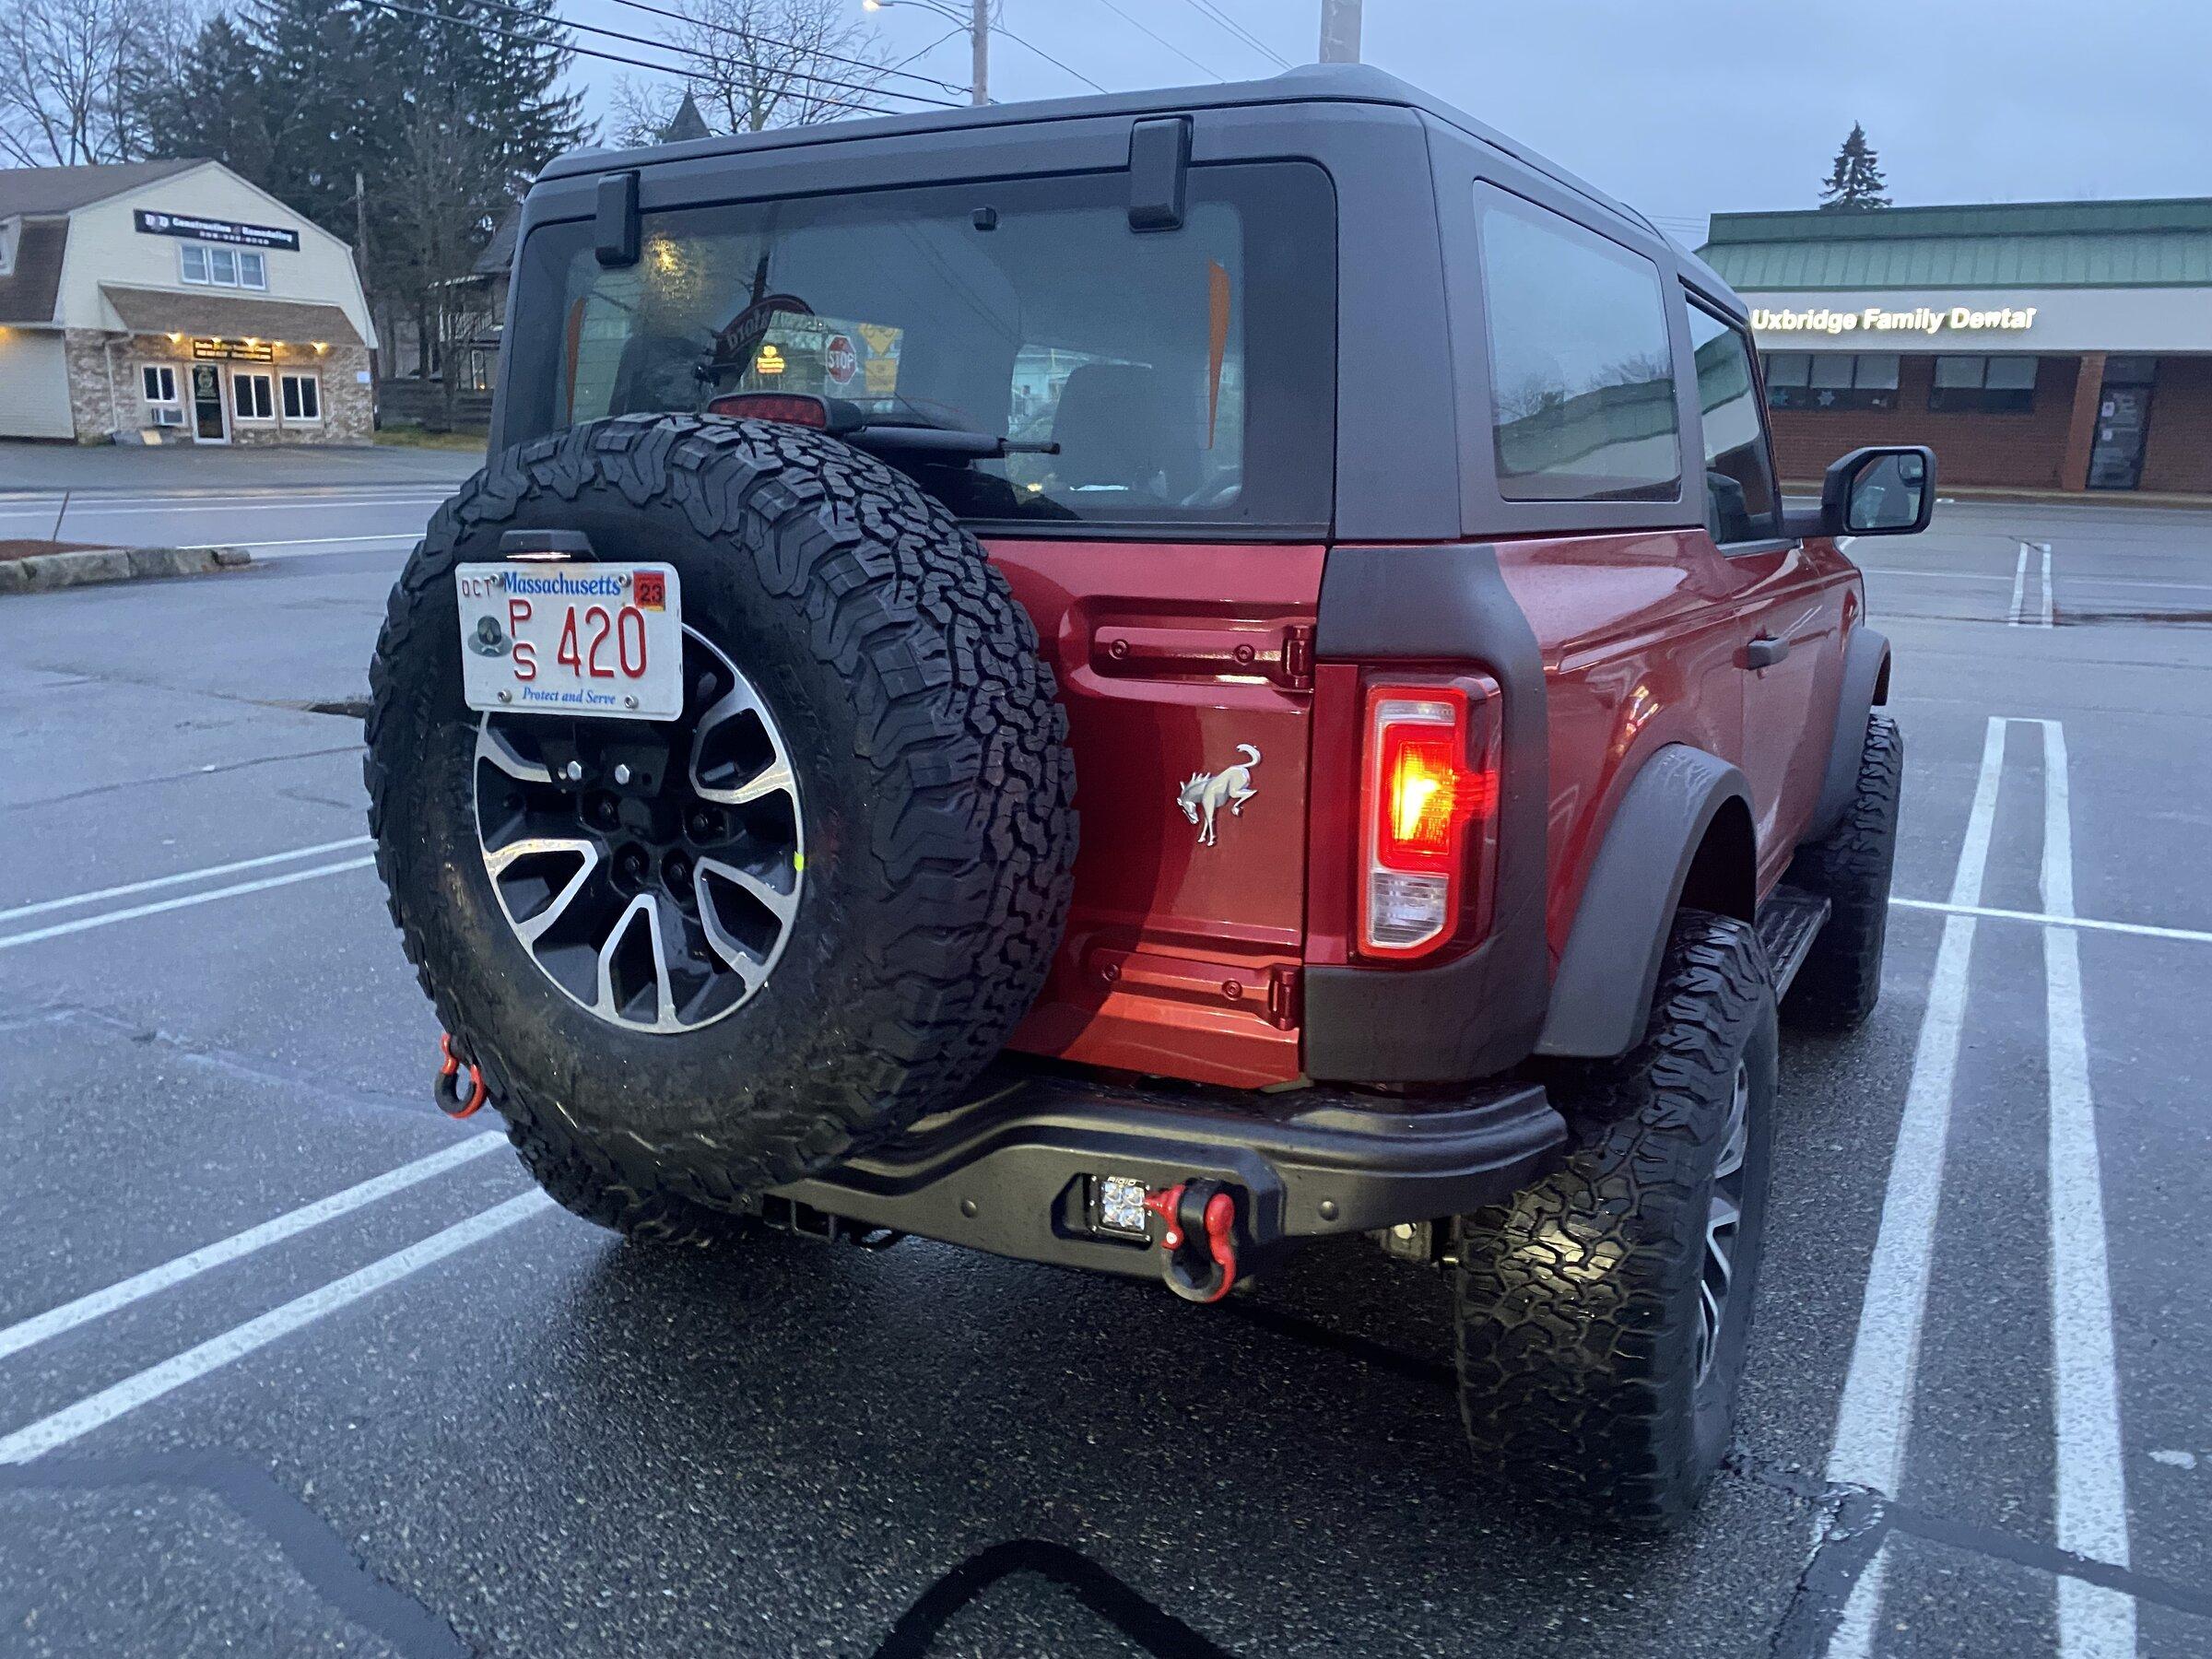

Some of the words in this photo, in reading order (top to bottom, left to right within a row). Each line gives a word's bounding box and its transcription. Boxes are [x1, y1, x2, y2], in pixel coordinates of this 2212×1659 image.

[1752, 309, 1857, 335] Uxbridge
[1864, 308, 1946, 335] Family
[1952, 307, 2037, 330] Dental
[829, 350, 856, 369] STOP
[462, 578, 491, 598] OCT
[503, 571, 621, 595] Massachusetts
[640, 584, 664, 602] 23
[557, 606, 647, 678] 420
[522, 687, 559, 700] Protect
[561, 690, 583, 703] and
[585, 689, 617, 705] Serve
[1107, 1176, 1136, 1186] RIGID
